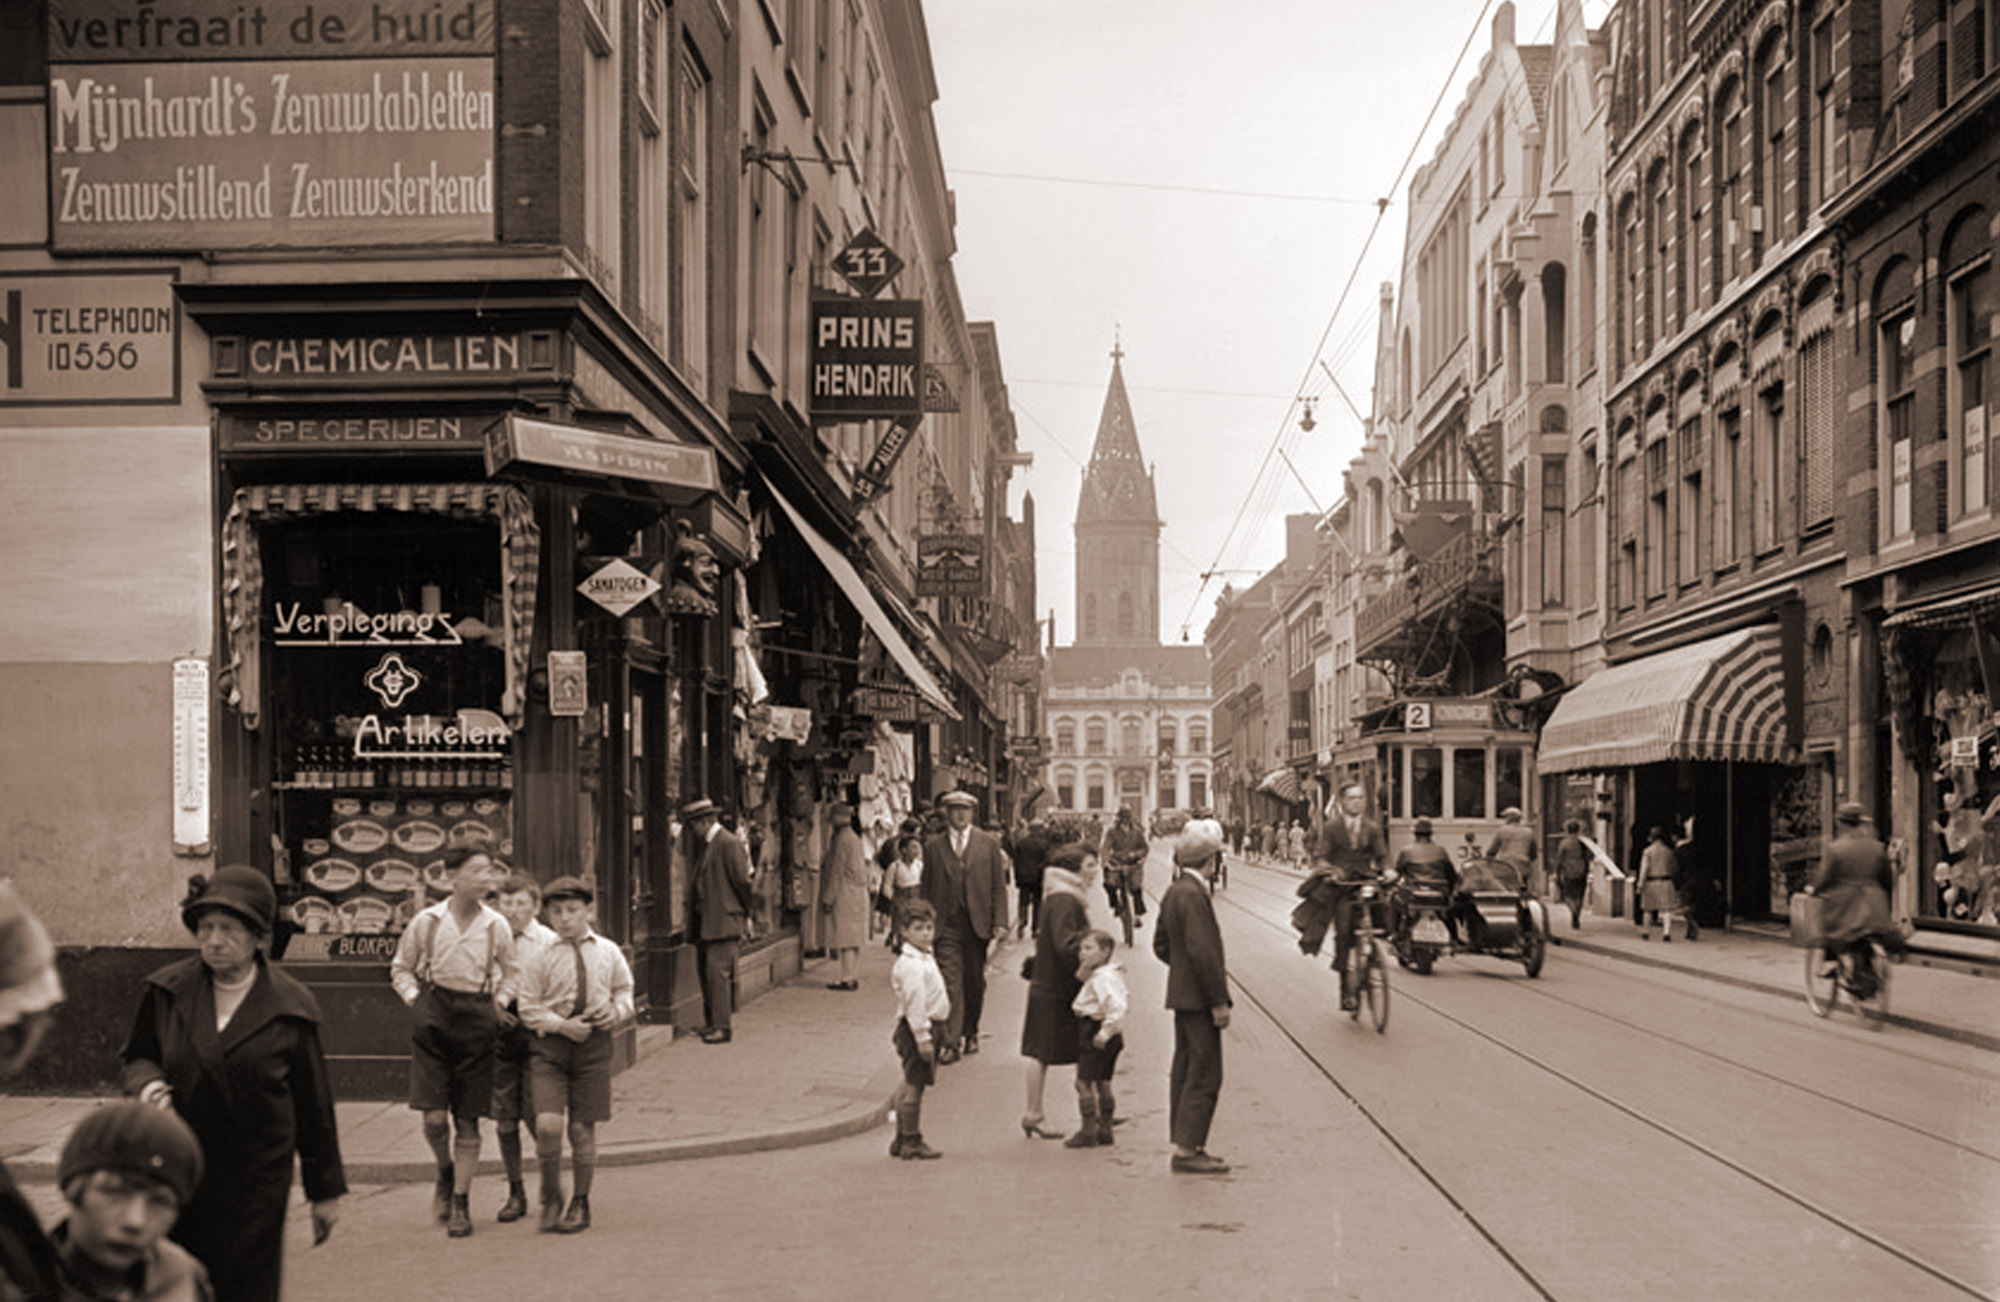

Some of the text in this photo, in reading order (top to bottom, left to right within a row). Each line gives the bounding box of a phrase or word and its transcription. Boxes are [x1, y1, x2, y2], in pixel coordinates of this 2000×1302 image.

[58, 2, 475, 48] verfraait de huid
[51, 70, 494, 153] Mijnhardt's Zenuwtabletten
[59, 158, 494, 223] Zenuwstillend Zenuwsterkend
[846, 247, 887, 276] 33
[32, 307, 171, 334] TELEPHOON
[818, 316, 914, 348] PRINS
[48, 341, 139, 371] 10556
[250, 335, 520, 374] CHEMICALIEN
[814, 363, 915, 397] HENDRIK
[255, 417, 462, 442] SPECERIJEN
[1410, 705, 1424, 725] 2
[355, 714, 513, 757] Artikelen
